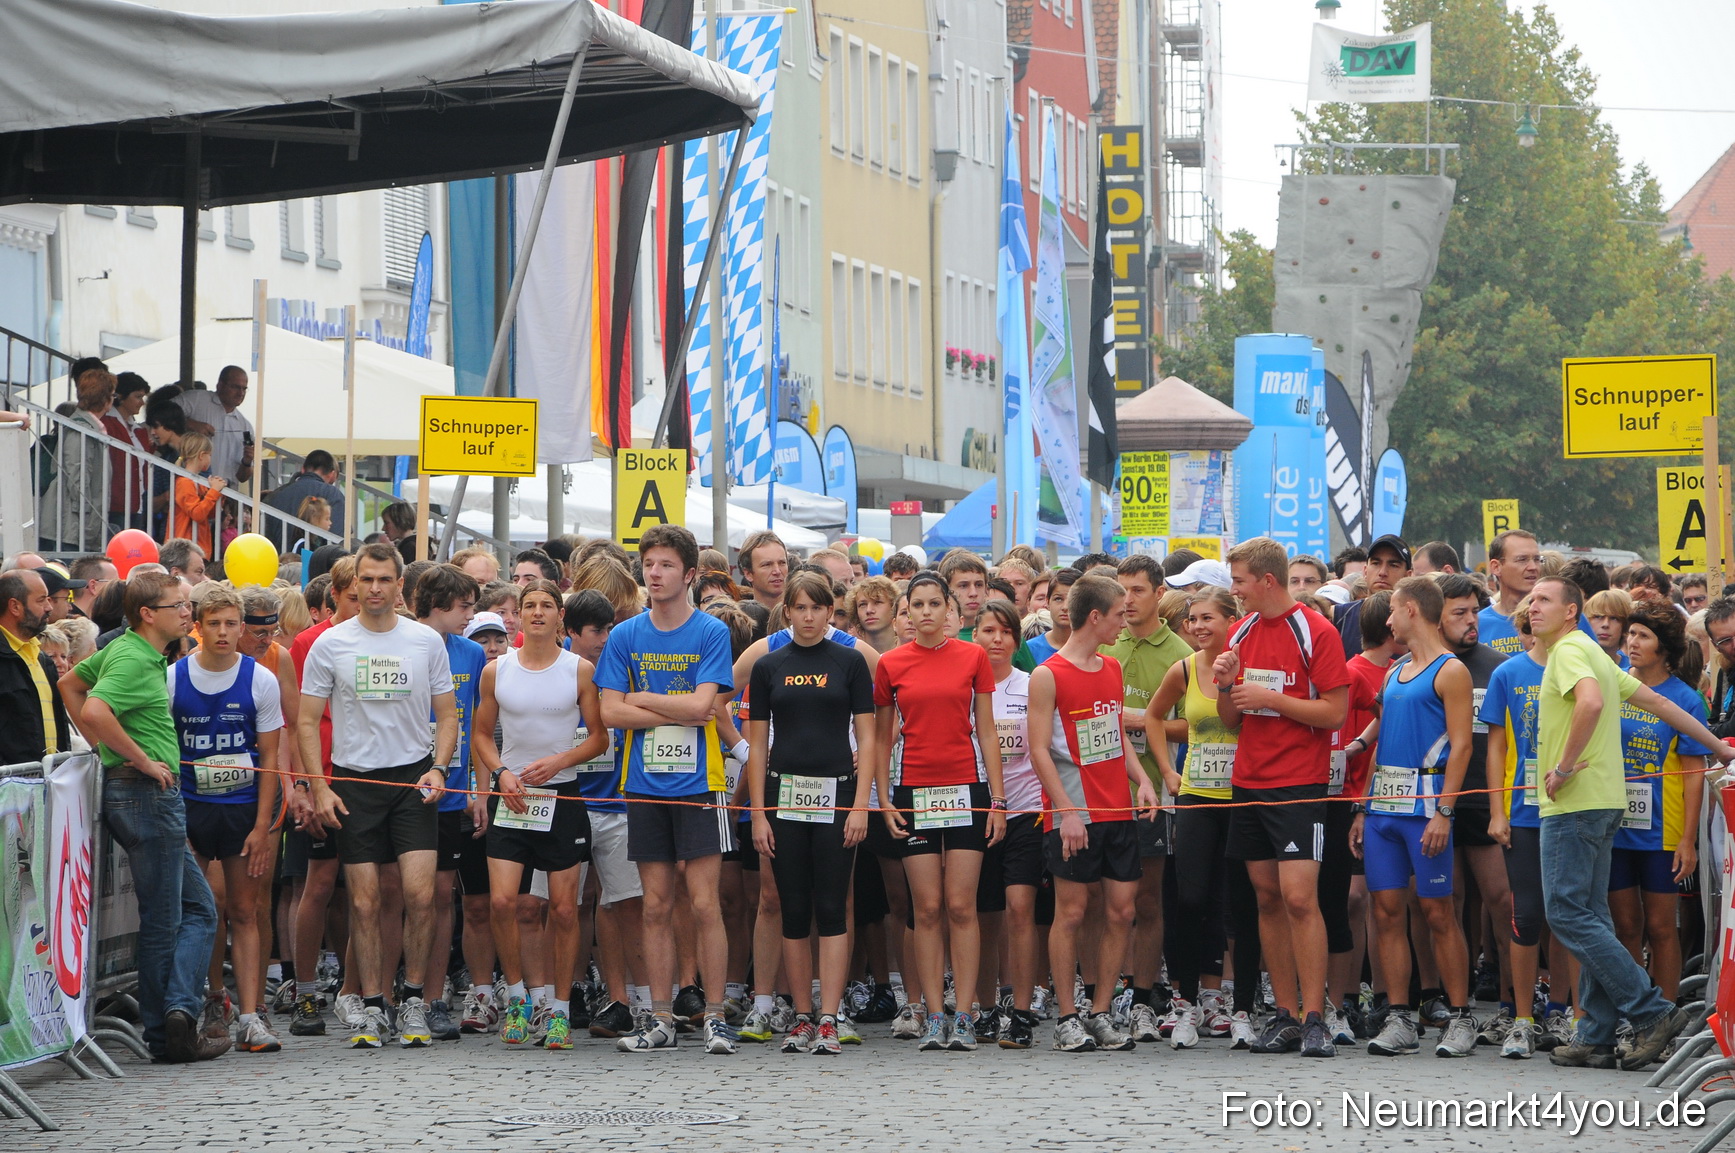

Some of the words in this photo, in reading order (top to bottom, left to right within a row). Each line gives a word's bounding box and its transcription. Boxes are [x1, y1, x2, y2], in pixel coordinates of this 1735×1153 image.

[1349, 46, 1412, 72] DAV
[1102, 132, 1143, 391] HOTEL
[1260, 369, 1309, 394] maxi
[1574, 387, 1704, 407] Schnupper-
[1619, 411, 1661, 431] lauf
[429, 418, 529, 438] Schnupper-
[462, 440, 495, 455] lauf
[625, 453, 678, 471] Block
[1134, 454, 1151, 462] Berlin
[1153, 453, 1167, 462] Club
[1123, 476, 1152, 504] 90
[1154, 492, 1168, 503] er
[631, 480, 669, 528] A
[1487, 502, 1514, 512] Block
[1675, 499, 1707, 550] A
[371, 659, 400, 667] Matthes
[631, 653, 641, 661] 10.
[642, 653, 700, 663] NEUMARKTER
[640, 662, 689, 672] STADTLAUF
[372, 673, 408, 685] 5129
[785, 674, 823, 687] ROXY
[1247, 672, 1278, 683] Alexander
[1514, 685, 1526, 695] 10.
[995, 723, 1021, 731] tharina
[1091, 721, 1107, 731] Björn
[999, 736, 1023, 748] 202
[1094, 730, 1119, 747] 5172
[657, 745, 692, 757] 5254
[209, 758, 235, 766] Florian
[213, 769, 247, 784] 5201
[795, 778, 822, 790] Isabella
[1382, 784, 1412, 796] 5157
[928, 787, 958, 795] Vanessa
[795, 794, 830, 808] 5042
[931, 798, 966, 813] 5015
[1629, 801, 1646, 813] 89
[522, 805, 549, 817] 186
